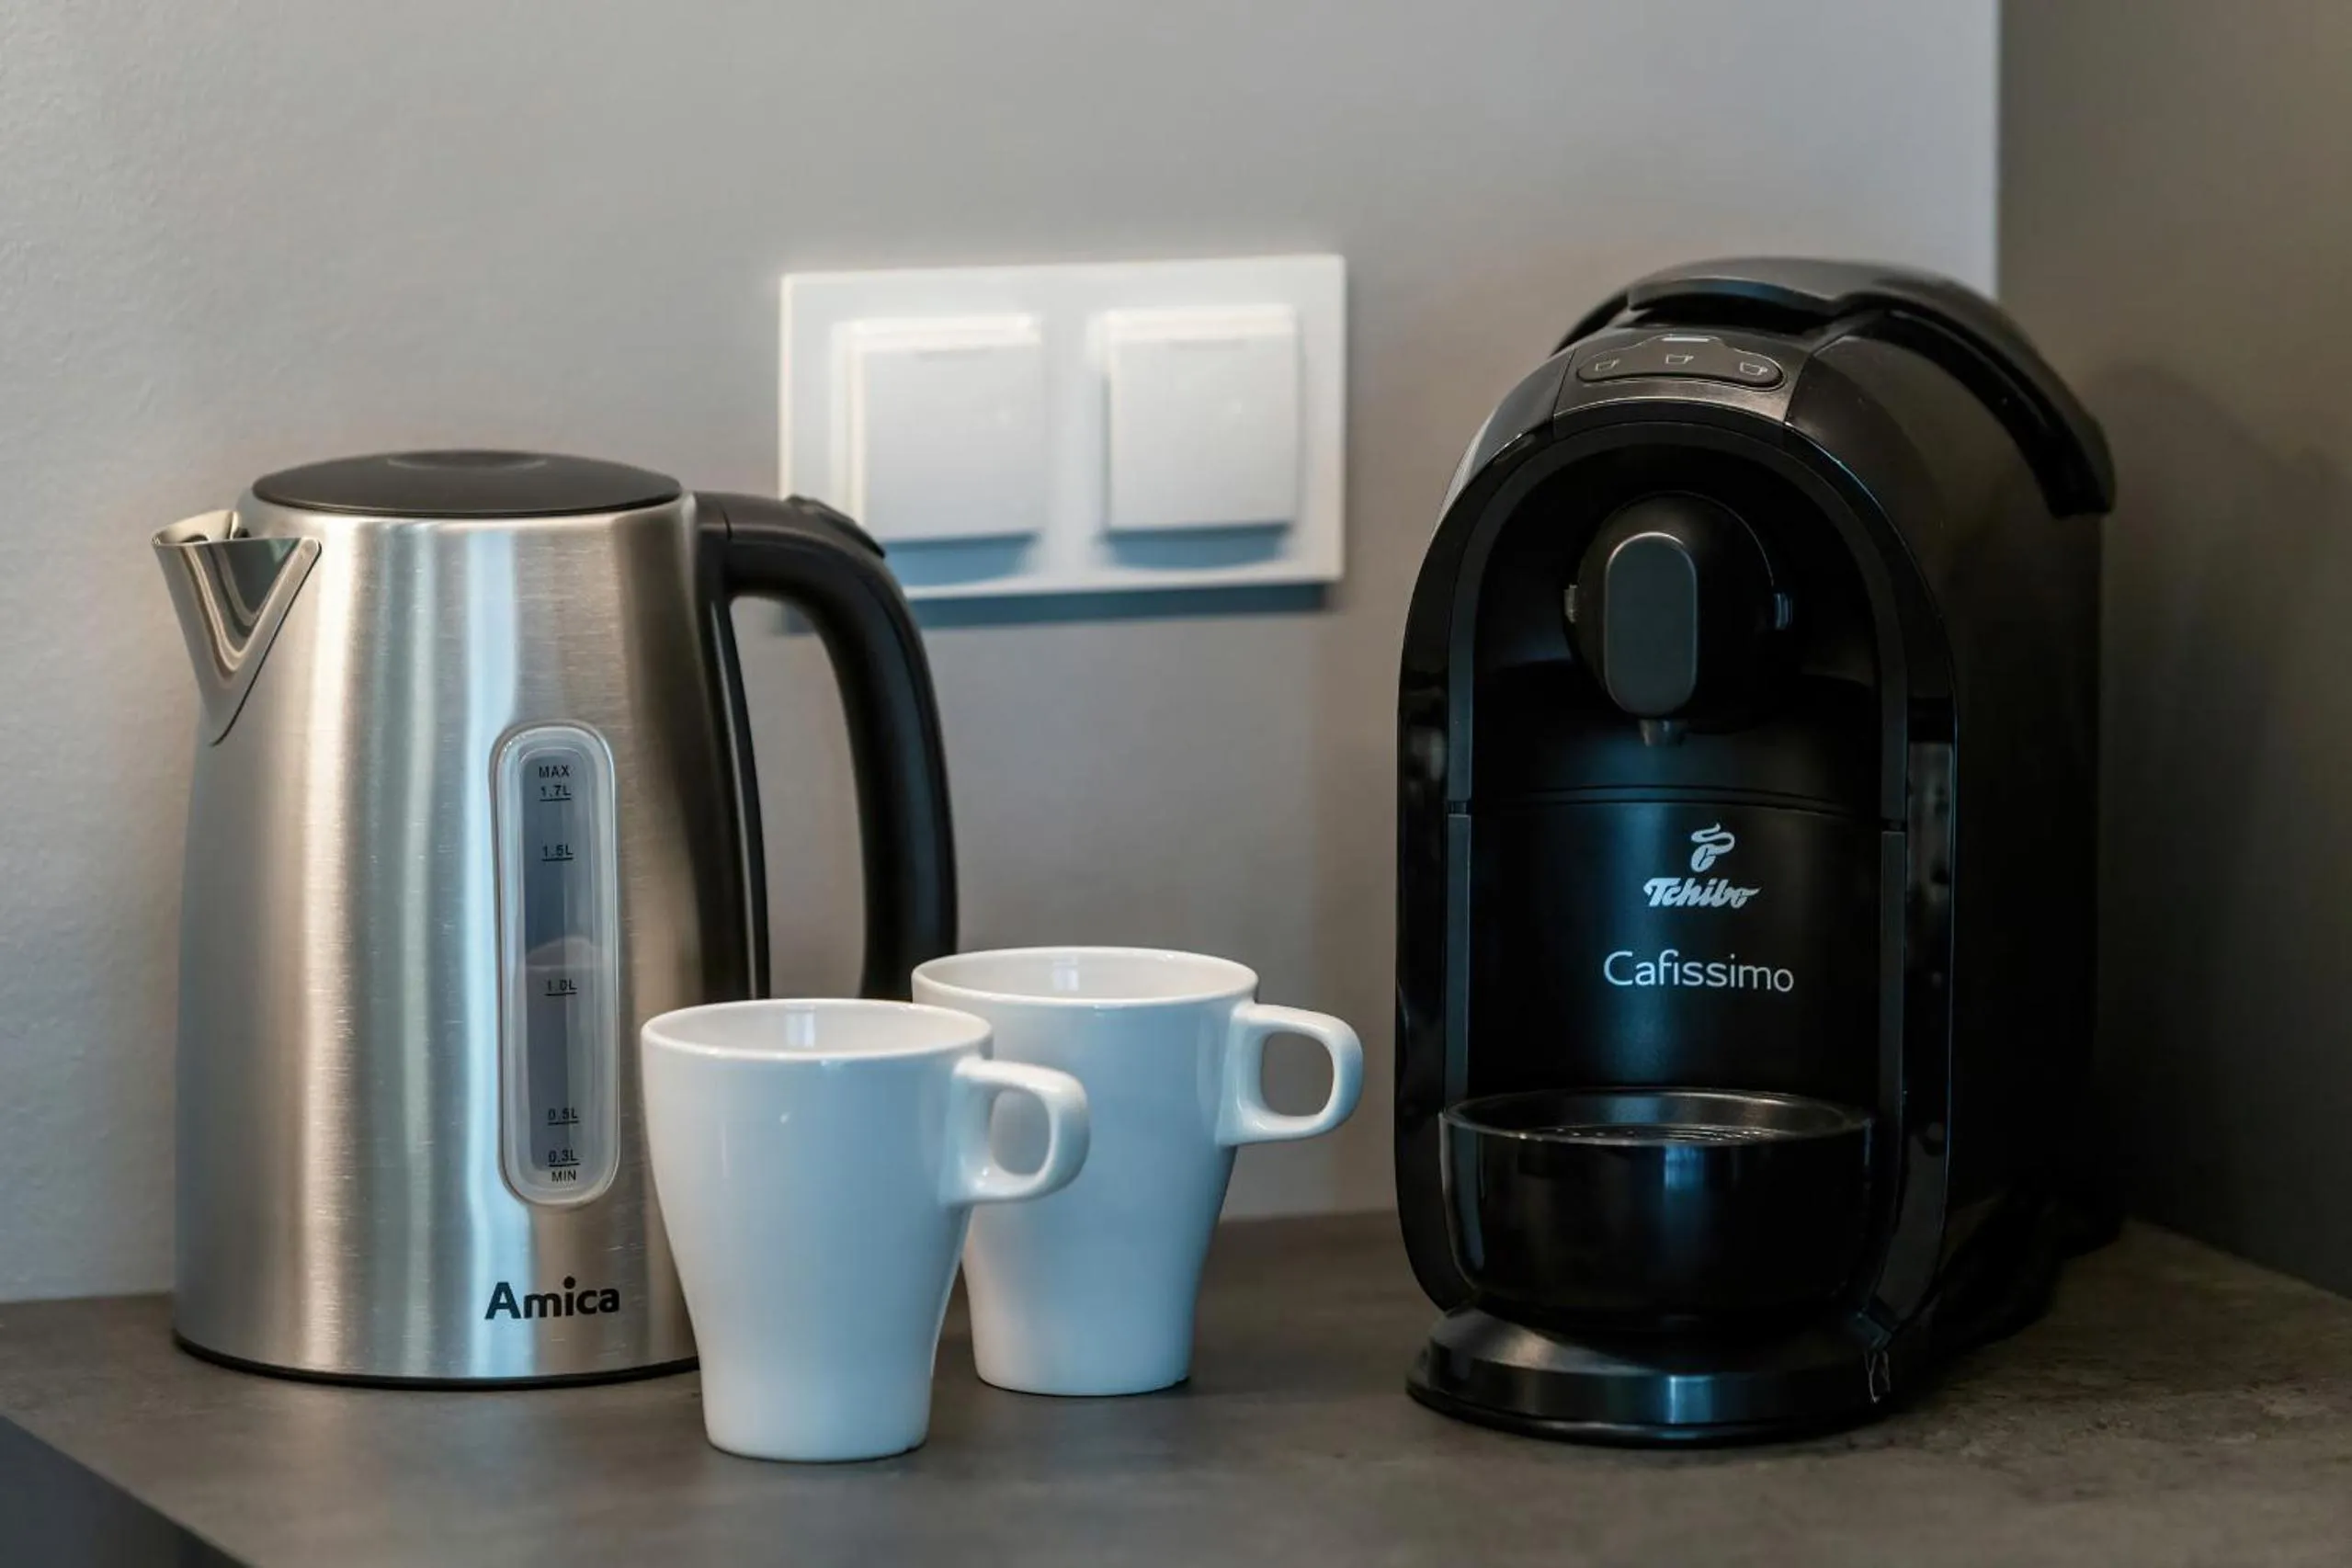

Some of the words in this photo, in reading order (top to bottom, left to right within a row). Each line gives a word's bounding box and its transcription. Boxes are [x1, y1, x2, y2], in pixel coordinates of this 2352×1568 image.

[539, 765, 571, 778] MAX
[540, 785, 572, 797] 1.7L
[1643, 877, 1761, 908] Tchibo
[1604, 949, 1794, 992] Cafissimo
[551, 1170, 577, 1183] MIN
[484, 1276, 620, 1320] Amica
